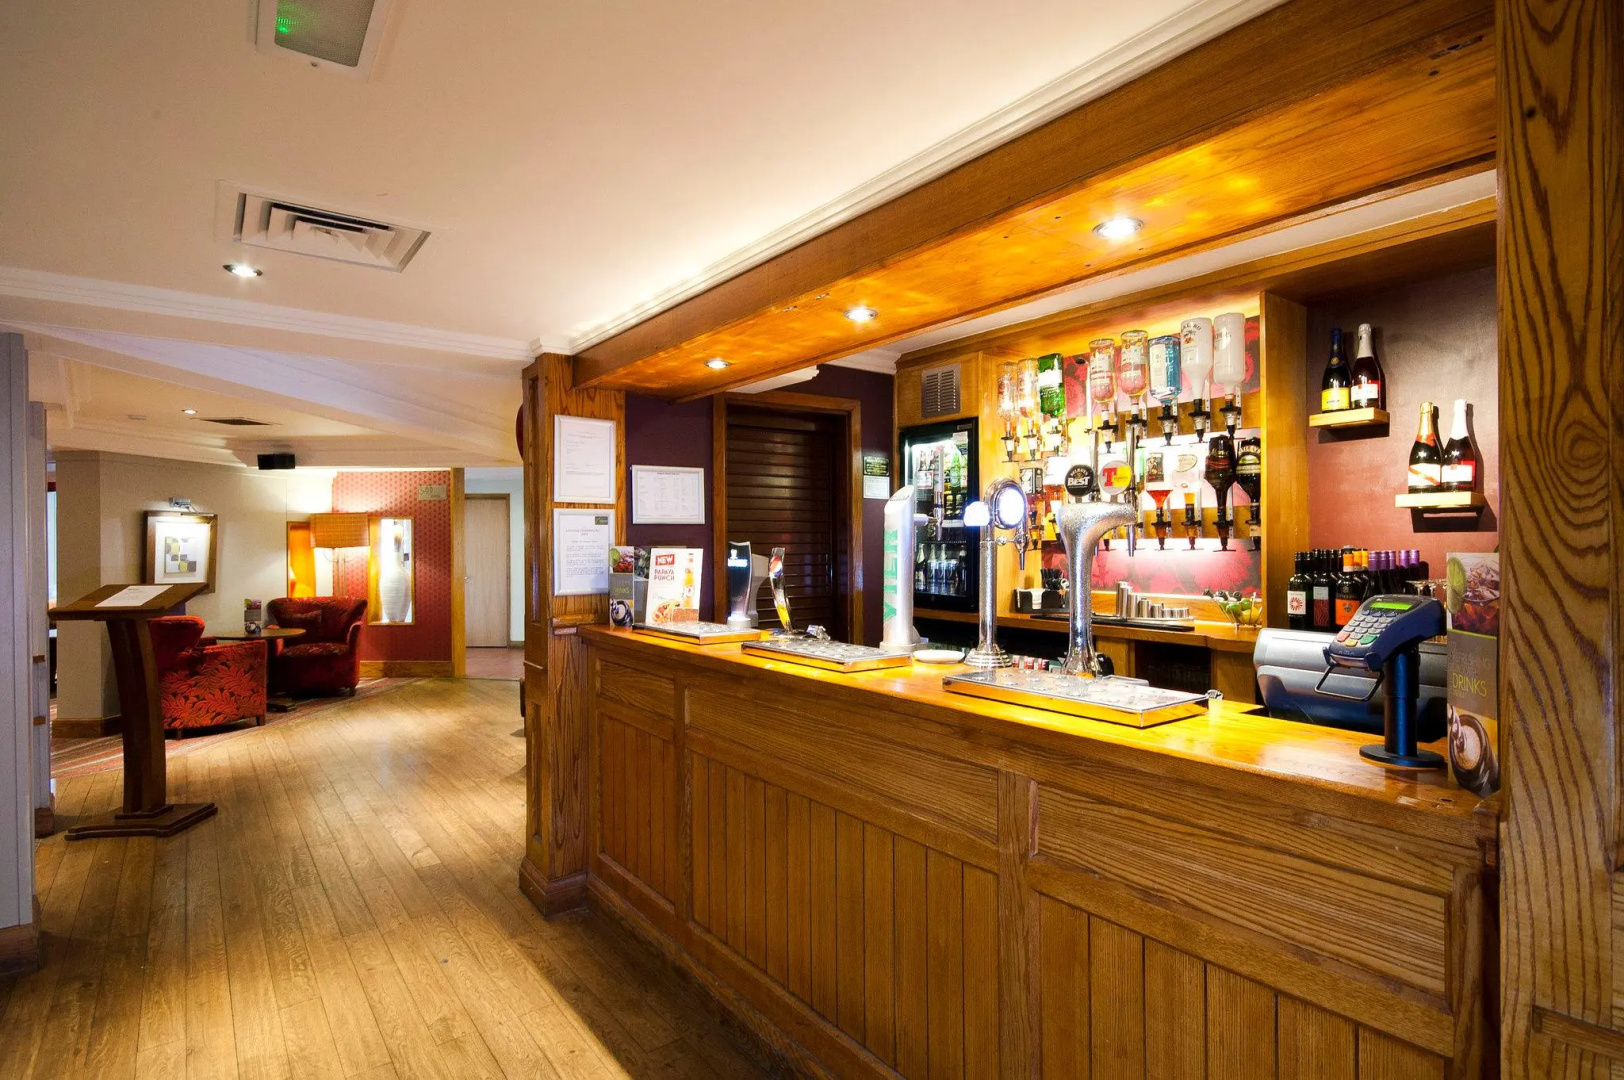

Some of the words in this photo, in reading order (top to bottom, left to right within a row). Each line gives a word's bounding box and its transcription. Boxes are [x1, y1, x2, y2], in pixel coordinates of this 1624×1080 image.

[1067, 476, 1090, 486] BEST
[657, 556, 674, 565] NEW
[1452, 672, 1487, 697] DRINKS
